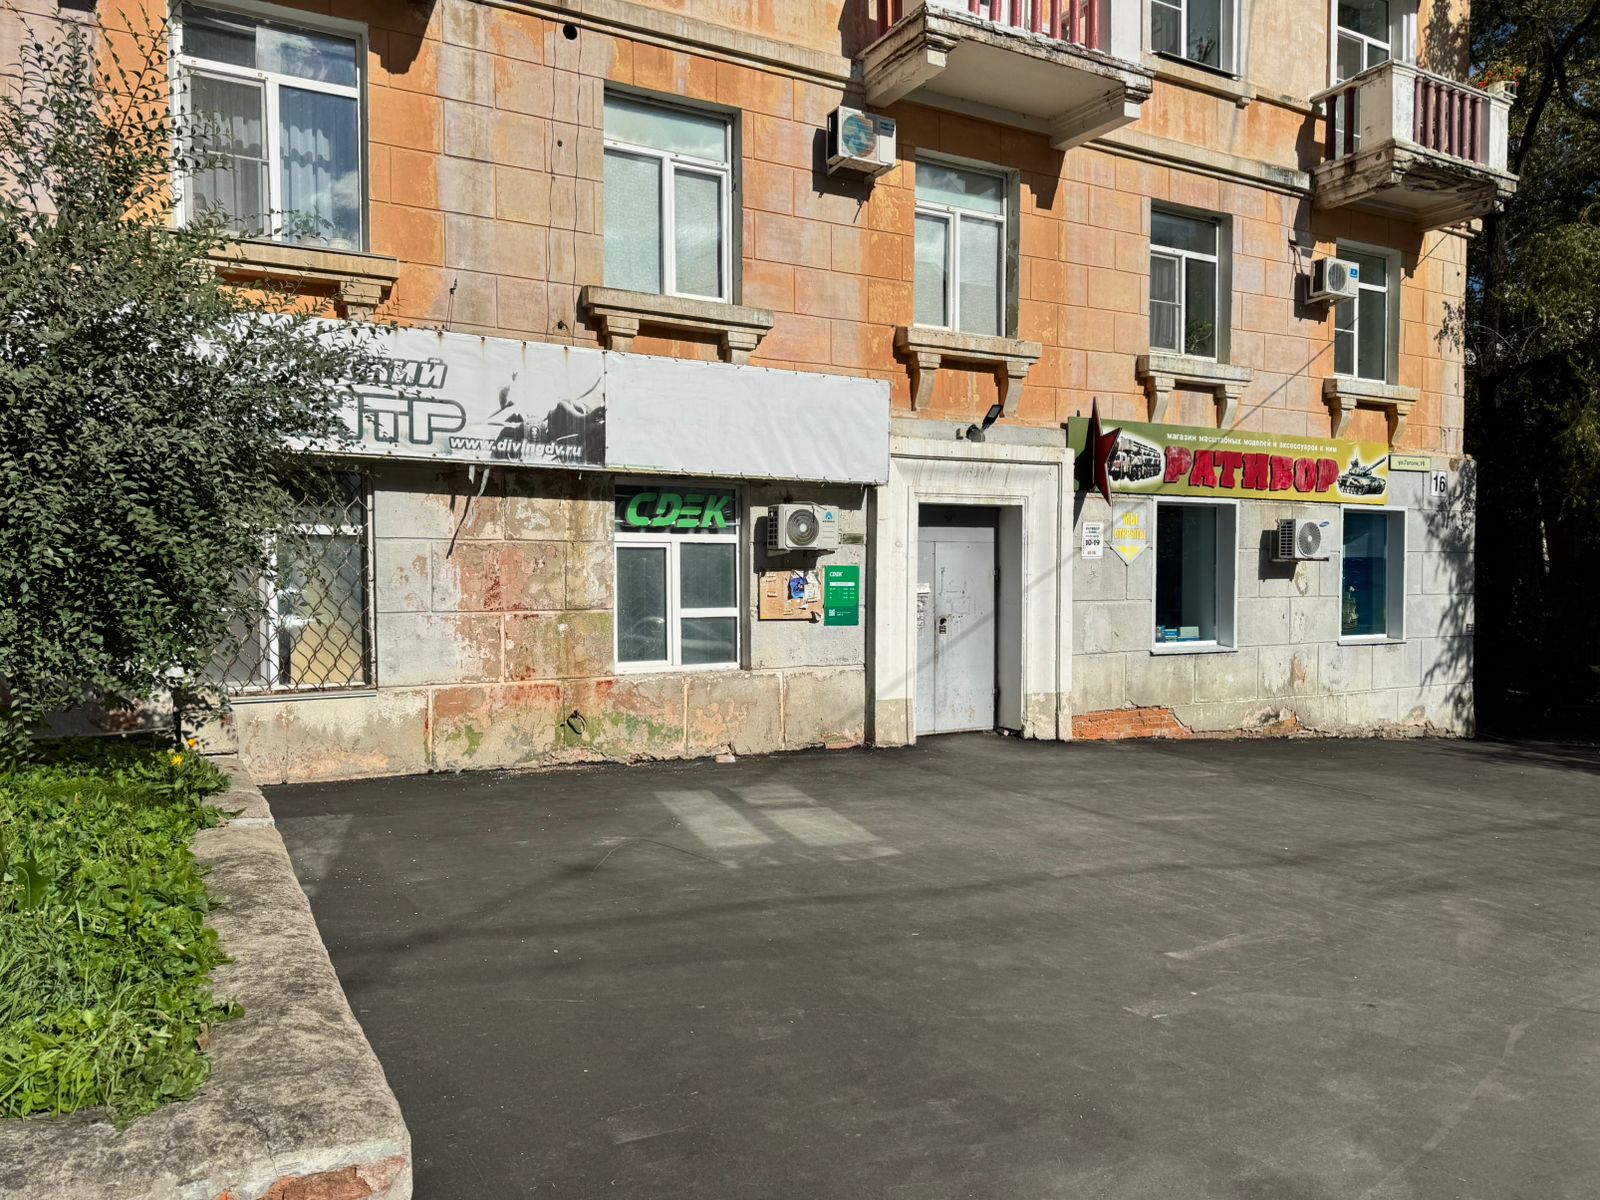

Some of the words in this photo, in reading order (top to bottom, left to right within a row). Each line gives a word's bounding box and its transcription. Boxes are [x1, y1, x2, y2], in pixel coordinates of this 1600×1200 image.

[1166, 432, 1197, 442] магазин
[1199, 435, 1242, 446] масштабных
[1243, 438, 1271, 449] моделей
[1279, 442, 1318, 453] аксессуаров
[1433, 475, 1446, 493] 16
[1124, 512, 1139, 526] МЫ
[1115, 529, 1146, 540] ОТКРЫТЫ
